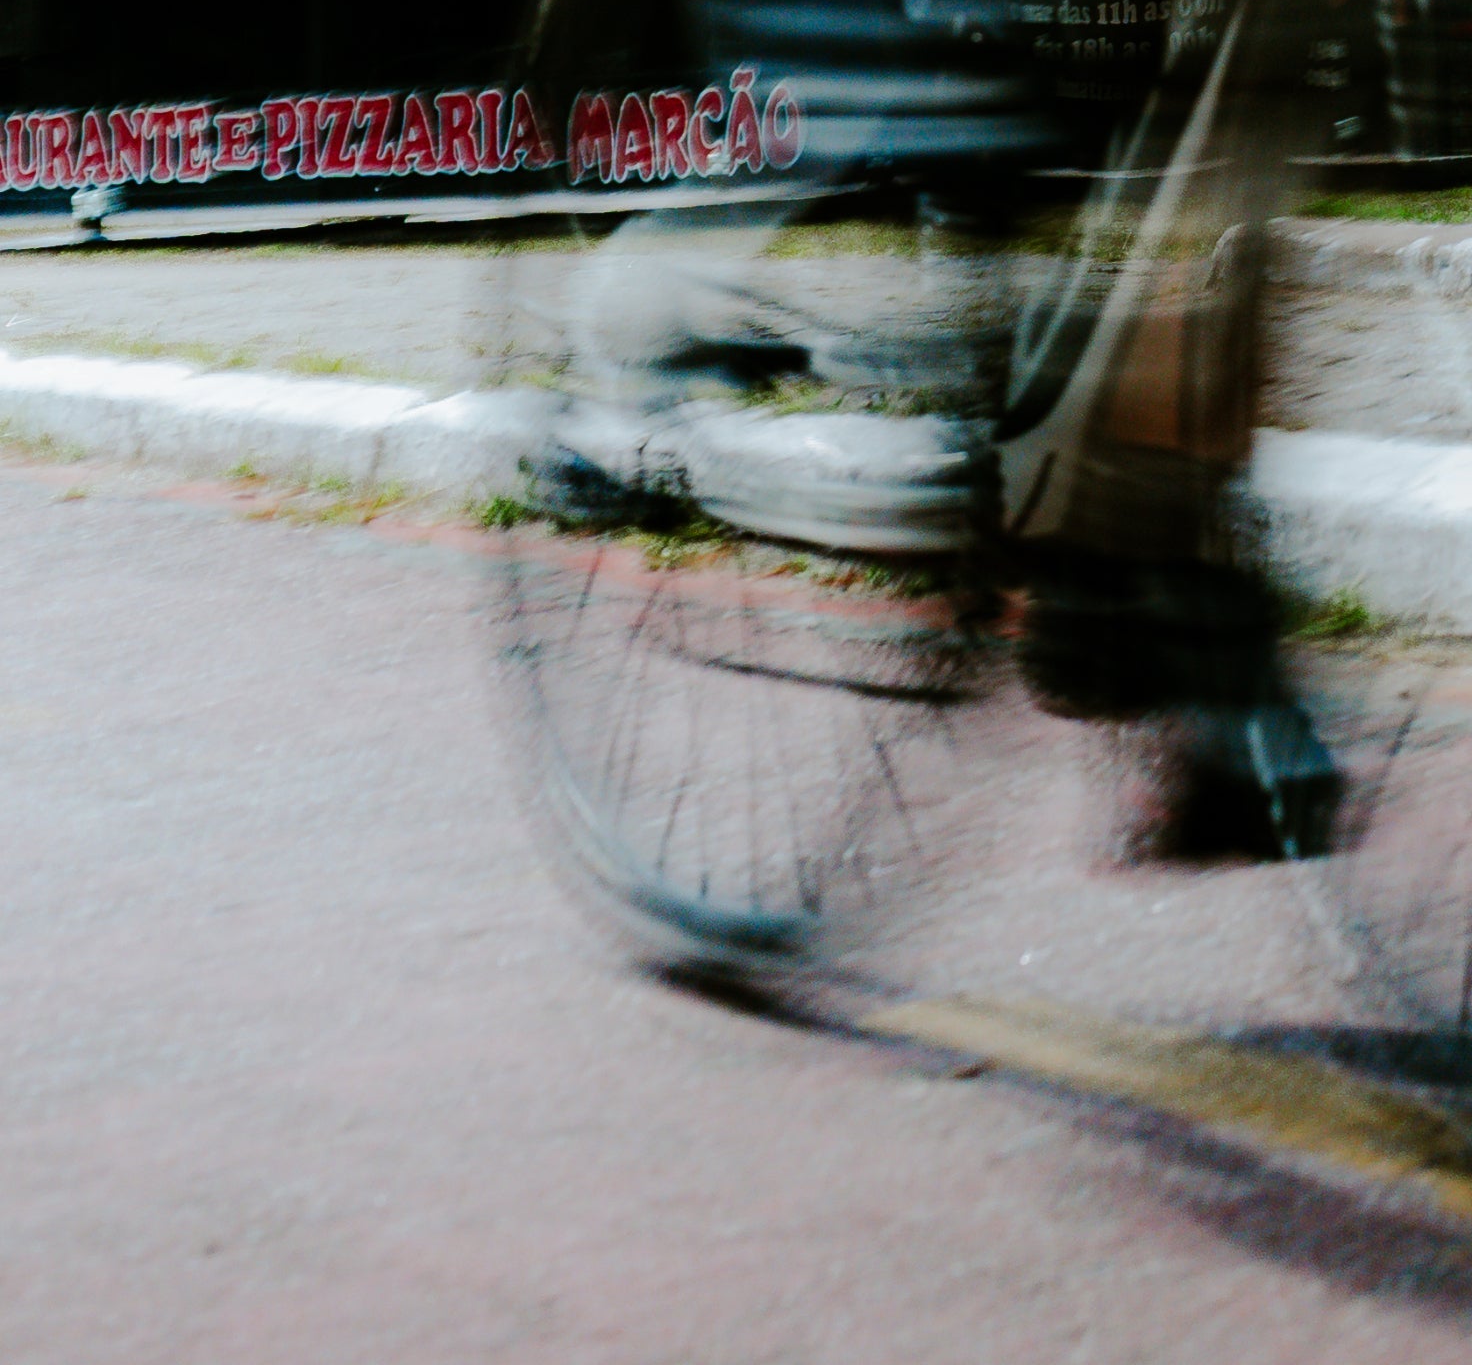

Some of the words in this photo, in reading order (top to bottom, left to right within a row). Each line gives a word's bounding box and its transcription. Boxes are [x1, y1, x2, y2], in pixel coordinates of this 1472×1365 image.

[1071, 36, 1115, 61] 18h
[0, 102, 214, 191] URANTE
[213, 112, 260, 171] E
[260, 87, 555, 181] PIZZARIA
